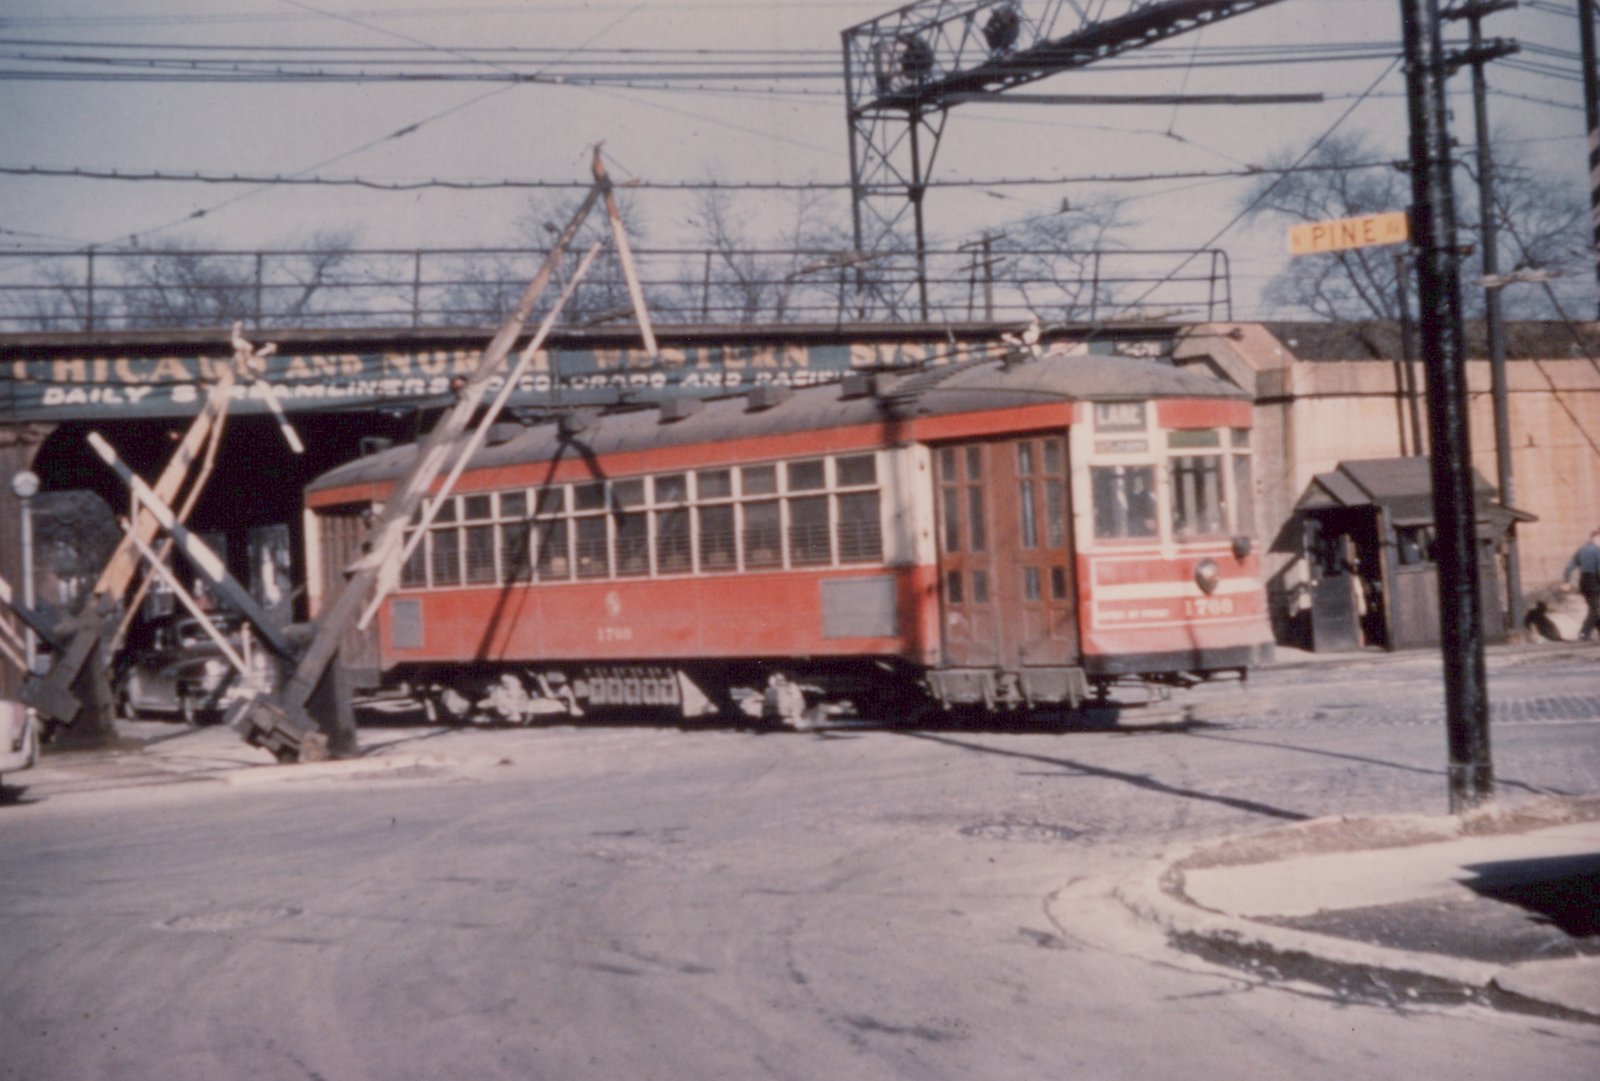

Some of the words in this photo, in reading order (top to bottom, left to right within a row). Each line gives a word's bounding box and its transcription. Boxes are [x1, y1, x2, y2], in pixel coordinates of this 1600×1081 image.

[1310, 218, 1377, 249] PINE
[285, 352, 363, 379] AND
[42, 385, 152, 405] DAILY
[680, 371, 742, 389] AND
